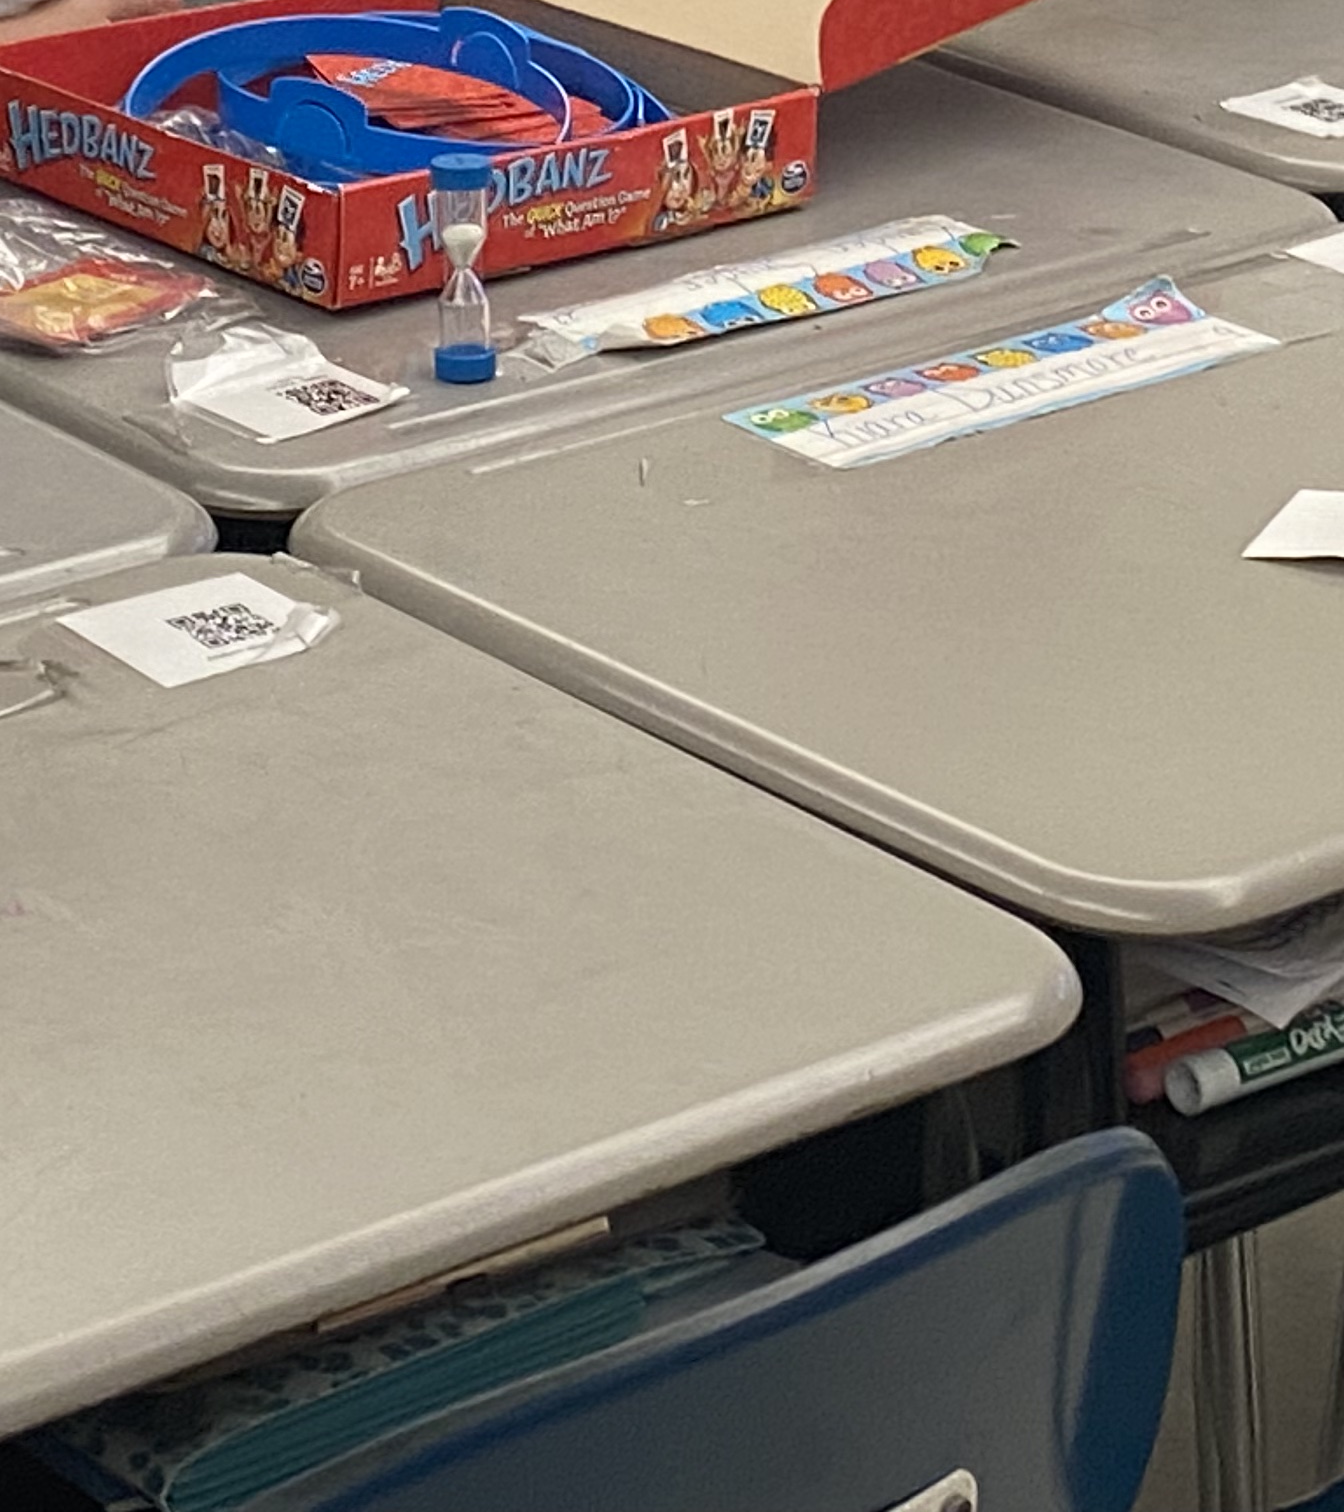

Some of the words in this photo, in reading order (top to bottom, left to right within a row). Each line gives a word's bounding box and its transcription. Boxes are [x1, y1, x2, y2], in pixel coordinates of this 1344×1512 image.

[7, 98, 158, 182] HEDBANZ
[502, 211, 525, 229] The
[526, 202, 565, 225] QUICK
[564, 196, 617, 218] Question
[617, 188, 652, 204] Game
